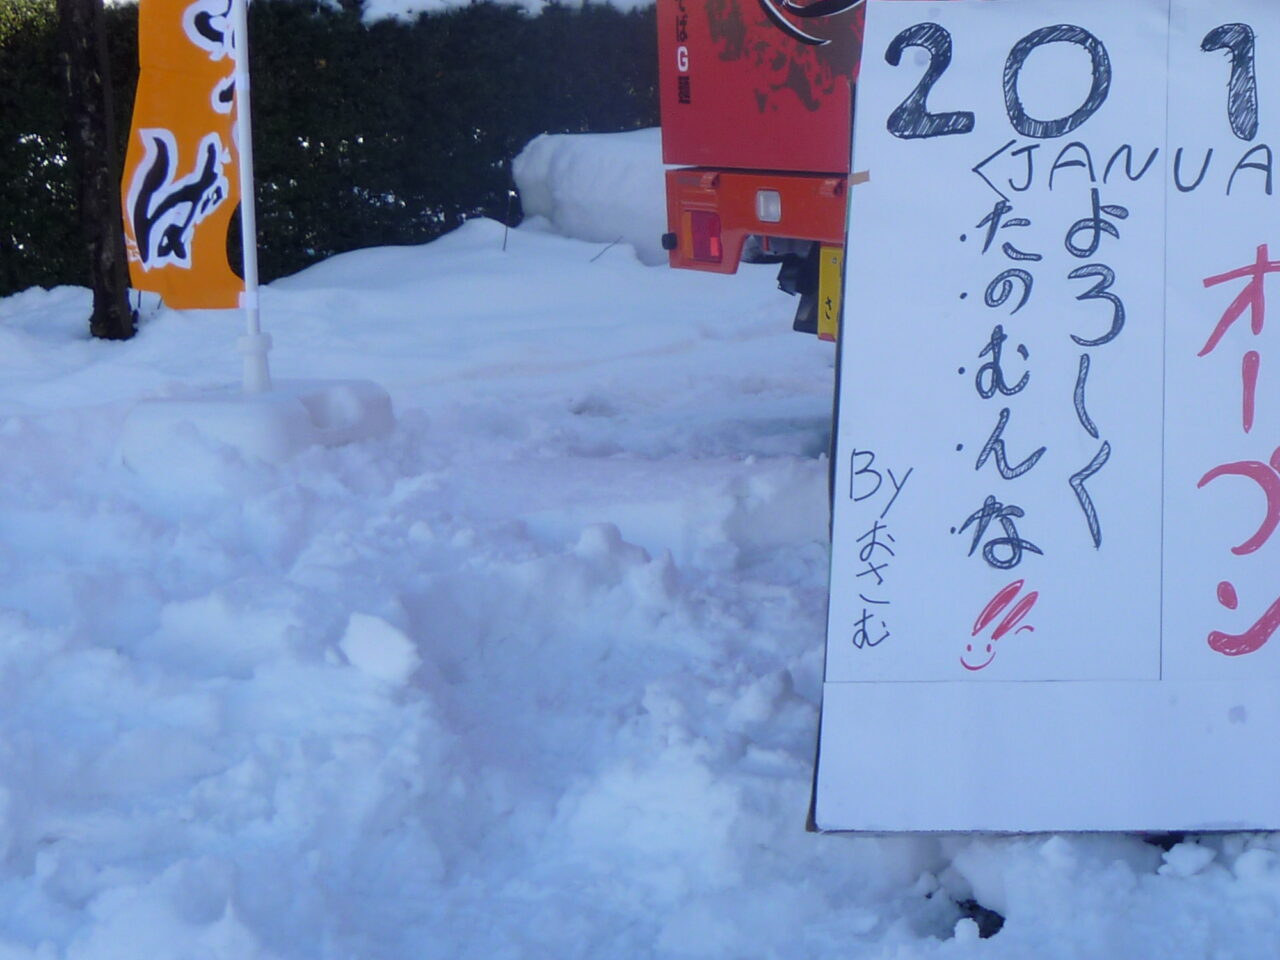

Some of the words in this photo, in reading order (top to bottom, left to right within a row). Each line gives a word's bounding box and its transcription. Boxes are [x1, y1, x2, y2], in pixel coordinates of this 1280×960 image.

[848, 449, 914, 517] By
[852, 520, 896, 649] おさむ
